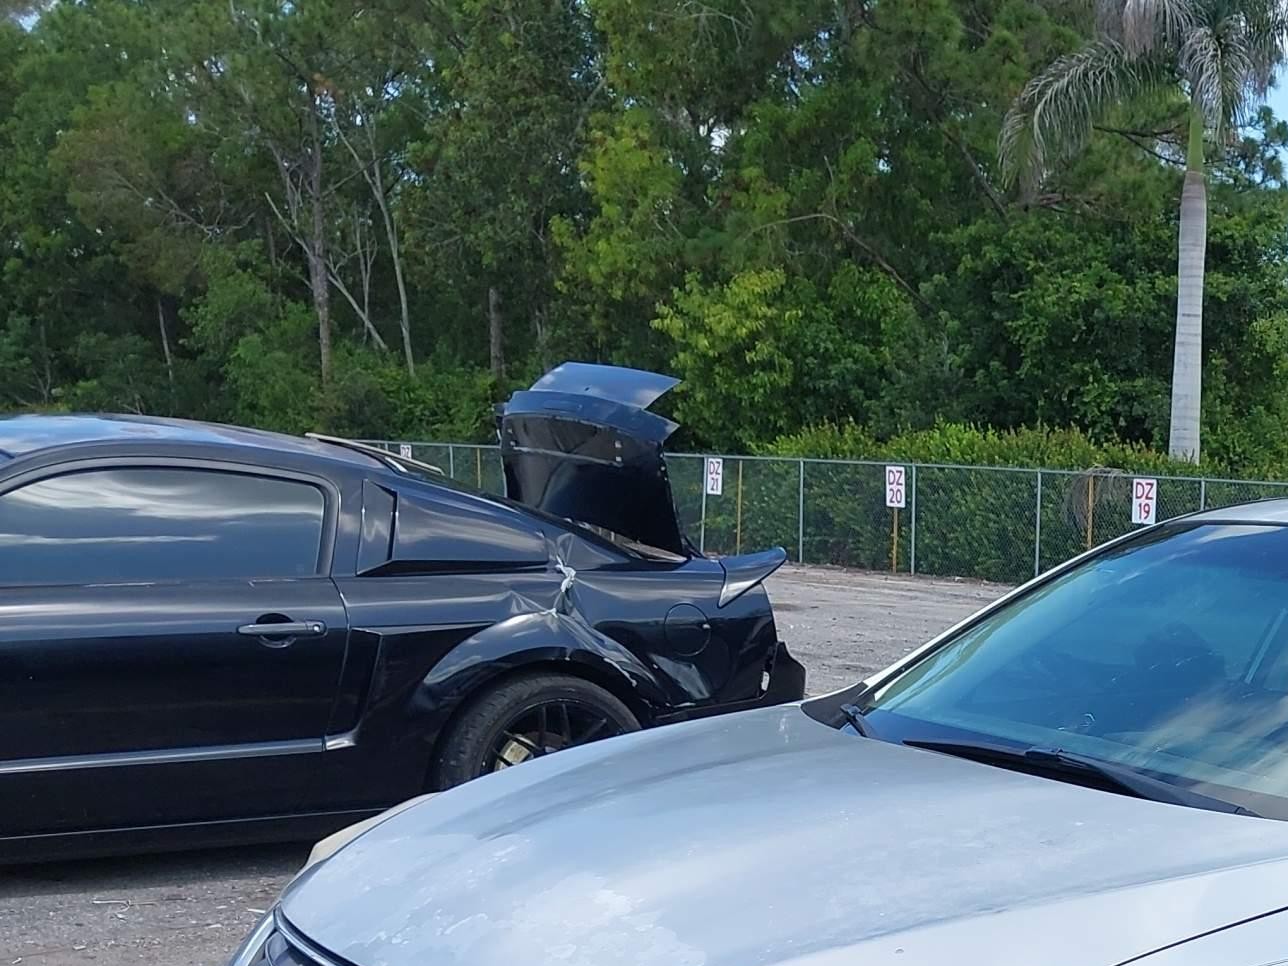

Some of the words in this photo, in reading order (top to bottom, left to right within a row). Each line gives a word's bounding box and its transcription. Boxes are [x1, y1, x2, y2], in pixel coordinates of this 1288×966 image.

[709, 460, 721, 475] DZ
[710, 477, 719, 491] 21
[888, 470, 903, 486] DZ
[889, 488, 902, 504] 20
[1135, 482, 1154, 500] DZ
[1138, 503, 1151, 520] 19
